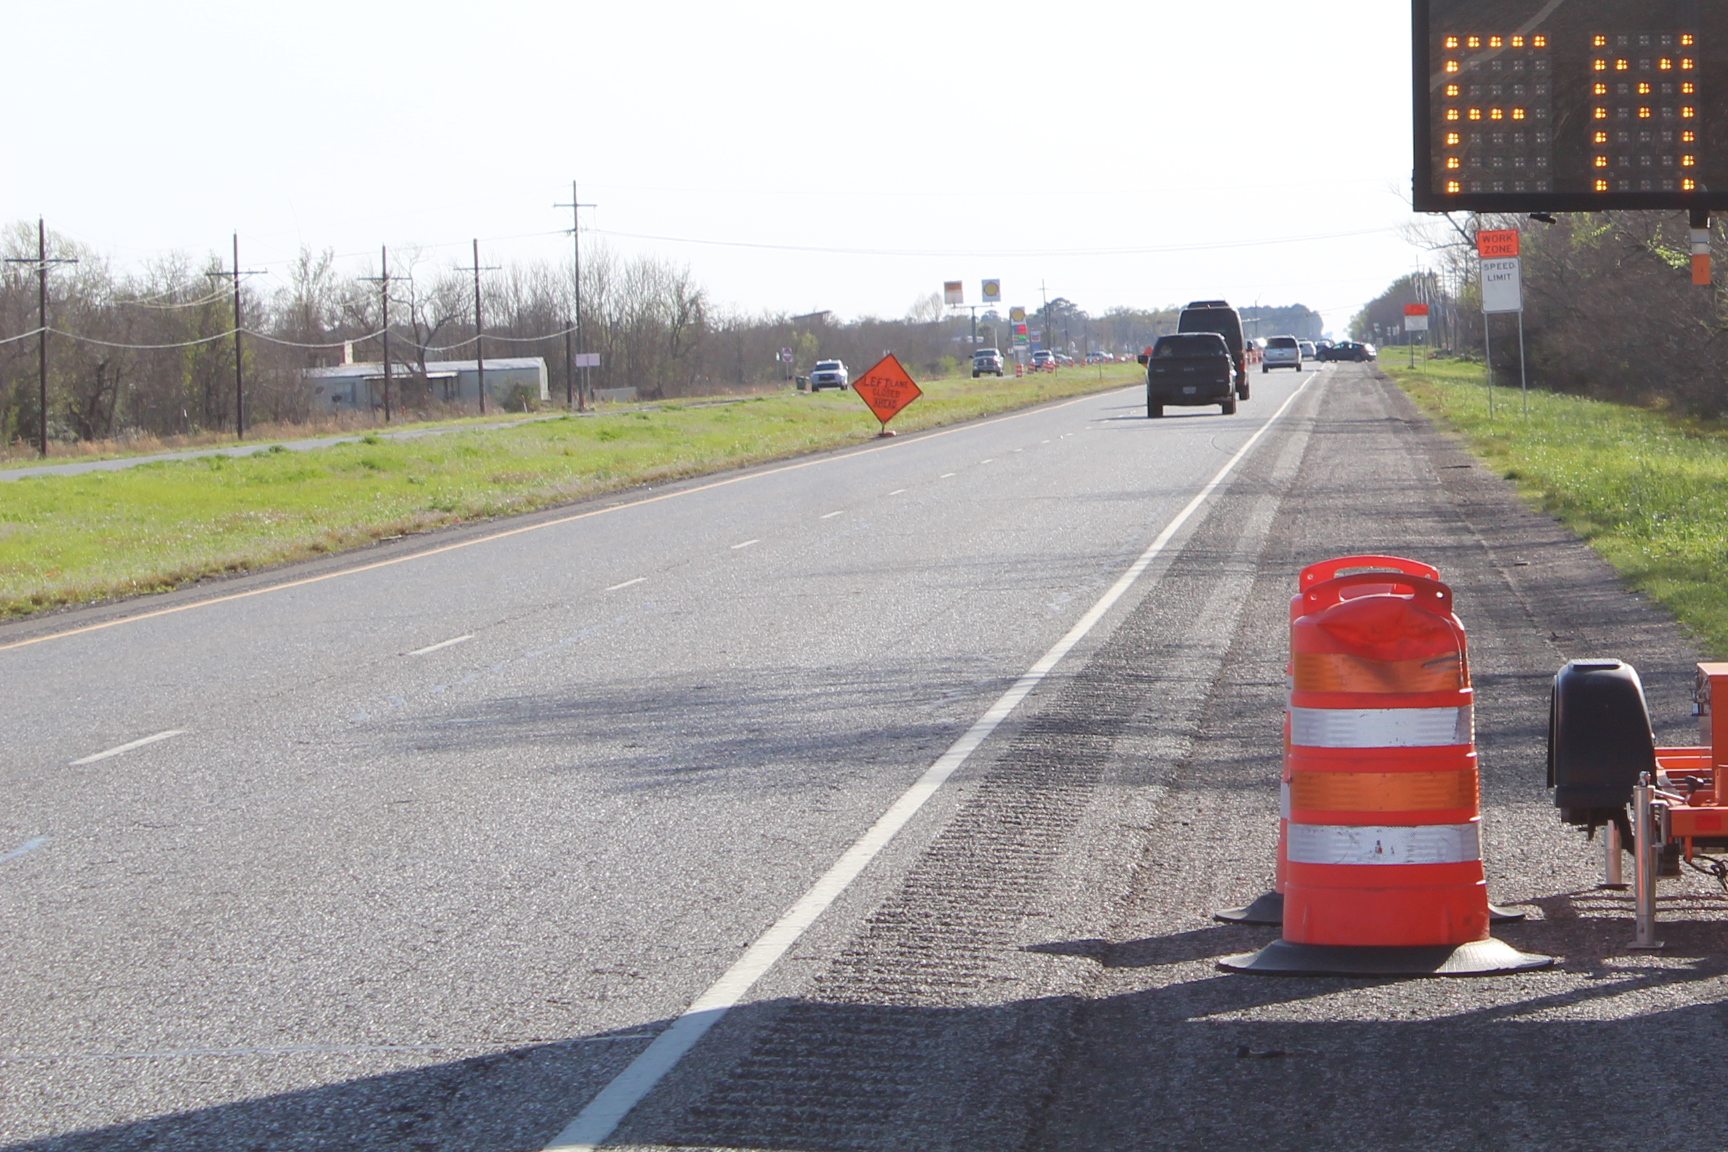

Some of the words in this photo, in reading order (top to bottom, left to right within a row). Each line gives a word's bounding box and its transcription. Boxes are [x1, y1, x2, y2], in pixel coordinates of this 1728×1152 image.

[1445, 33, 1695, 193] FM
[1482, 234, 1513, 243] WORK
[1484, 245, 1513, 254] ZONE
[1483, 262, 1515, 271] SPEED
[1487, 274, 1512, 282] LIMIT
[863, 376, 890, 388] LEFT
[890, 380, 909, 389] LANE
[873, 388, 900, 398] CLOSED
[874, 398, 897, 408] AHEAD
